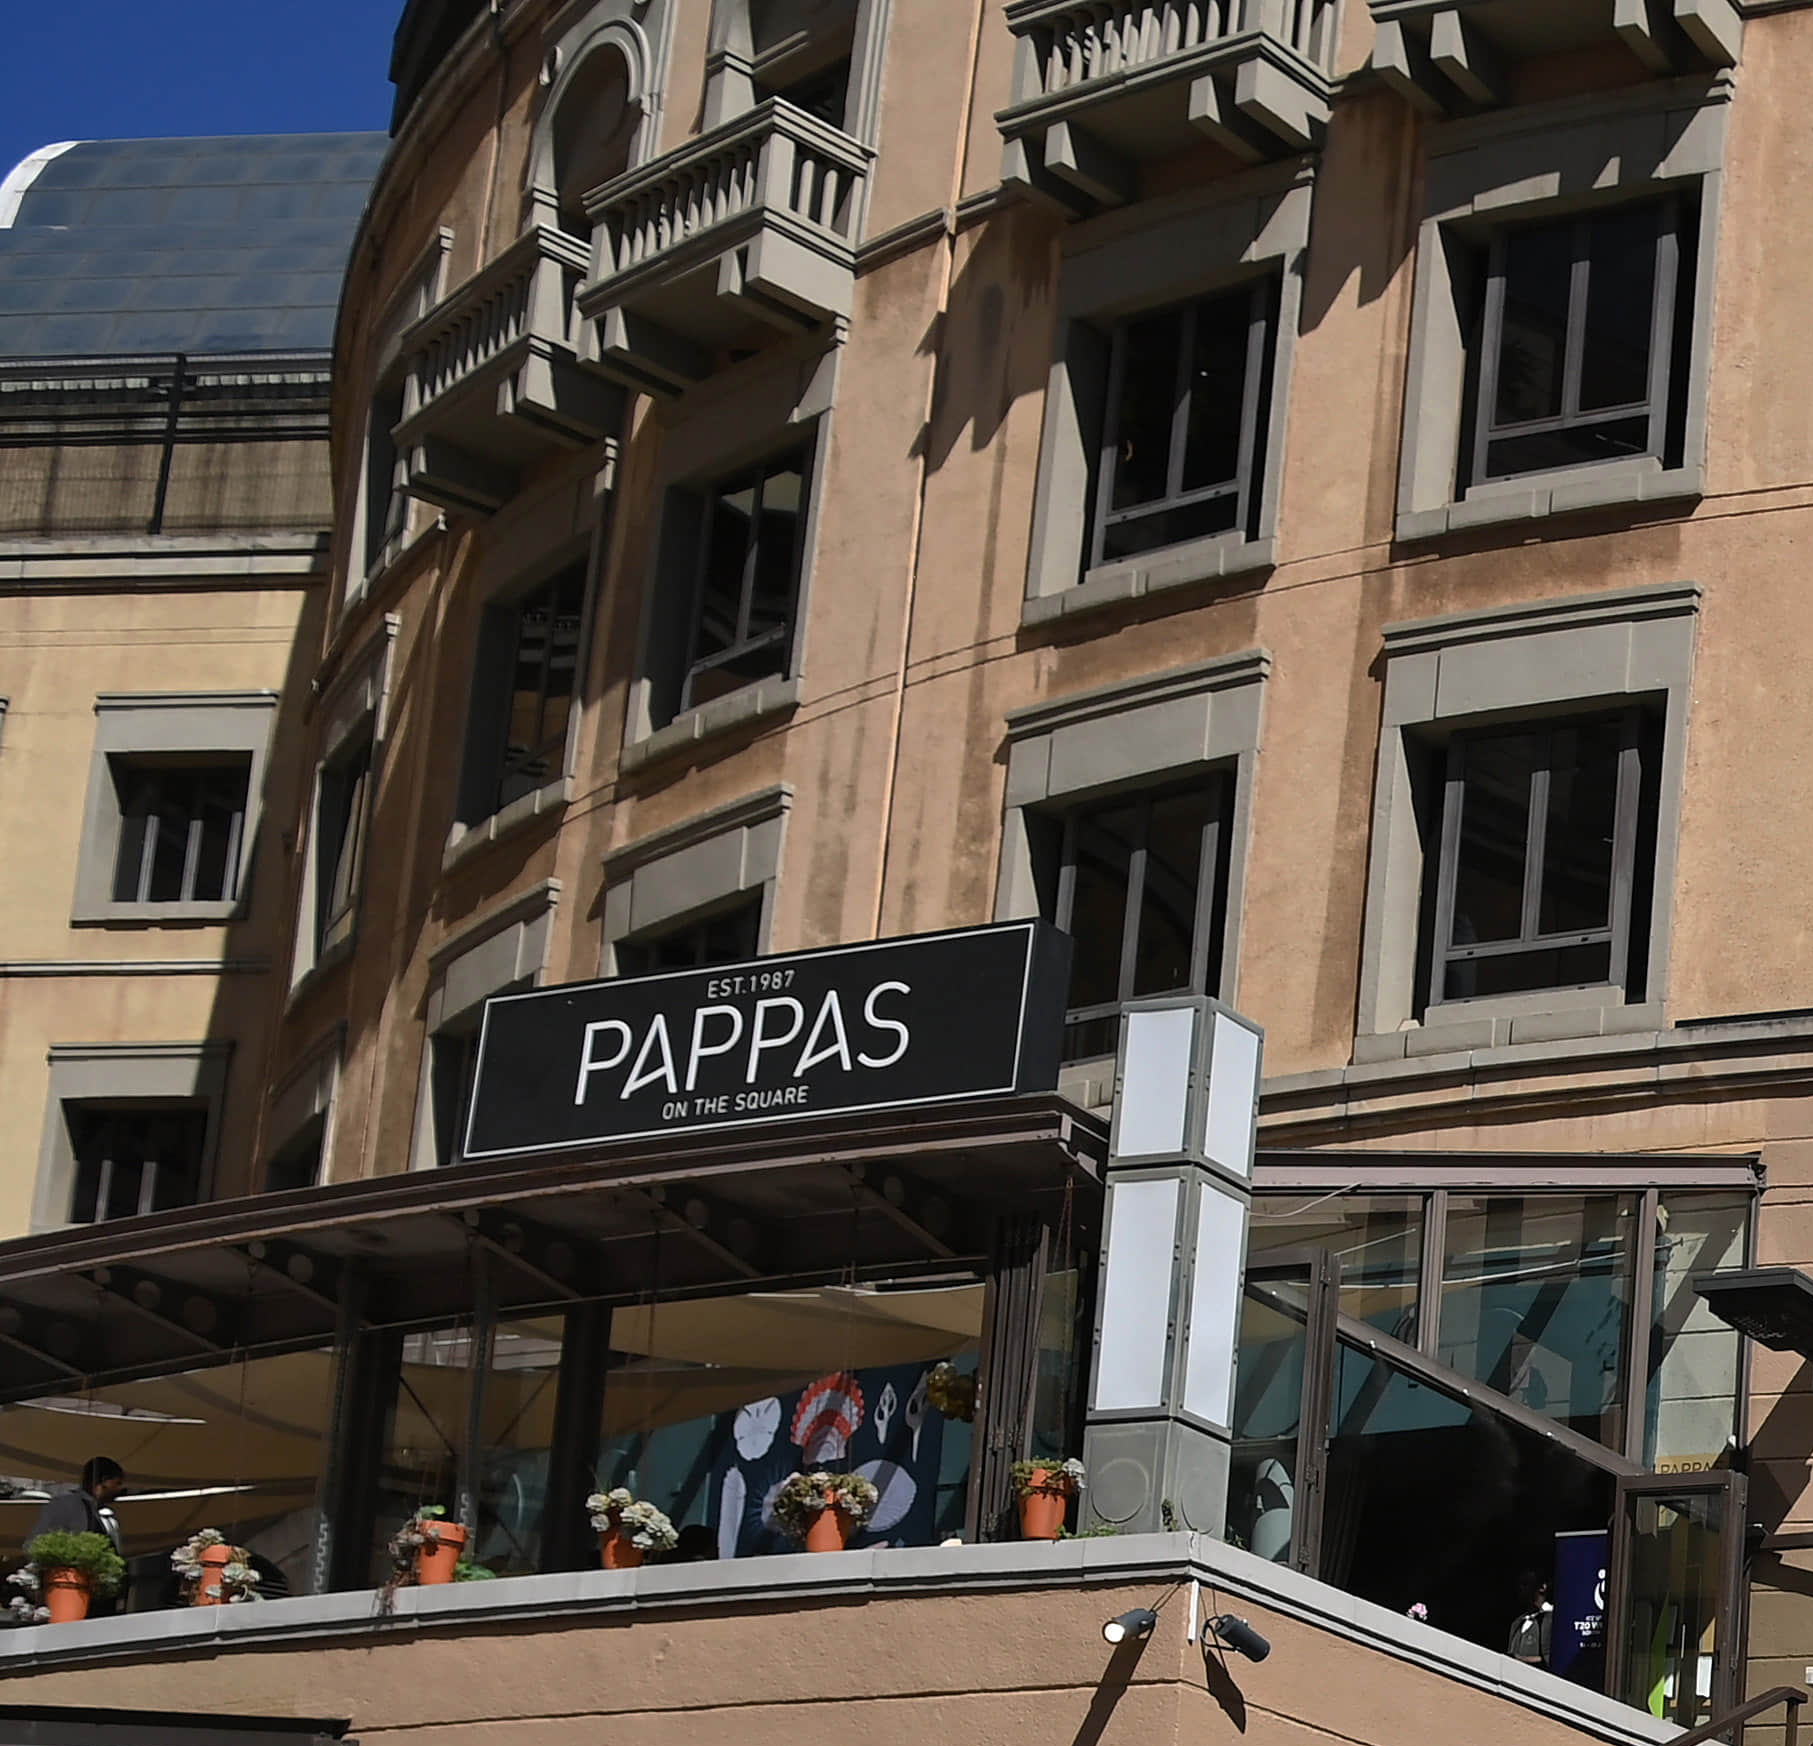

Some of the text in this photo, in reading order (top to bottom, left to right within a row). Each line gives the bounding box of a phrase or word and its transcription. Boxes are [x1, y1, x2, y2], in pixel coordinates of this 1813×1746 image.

[707, 970, 795, 999] EST.1987
[574, 980, 912, 1105] PAPPAS
[662, 1085, 809, 1120] ON THE SQUARE
